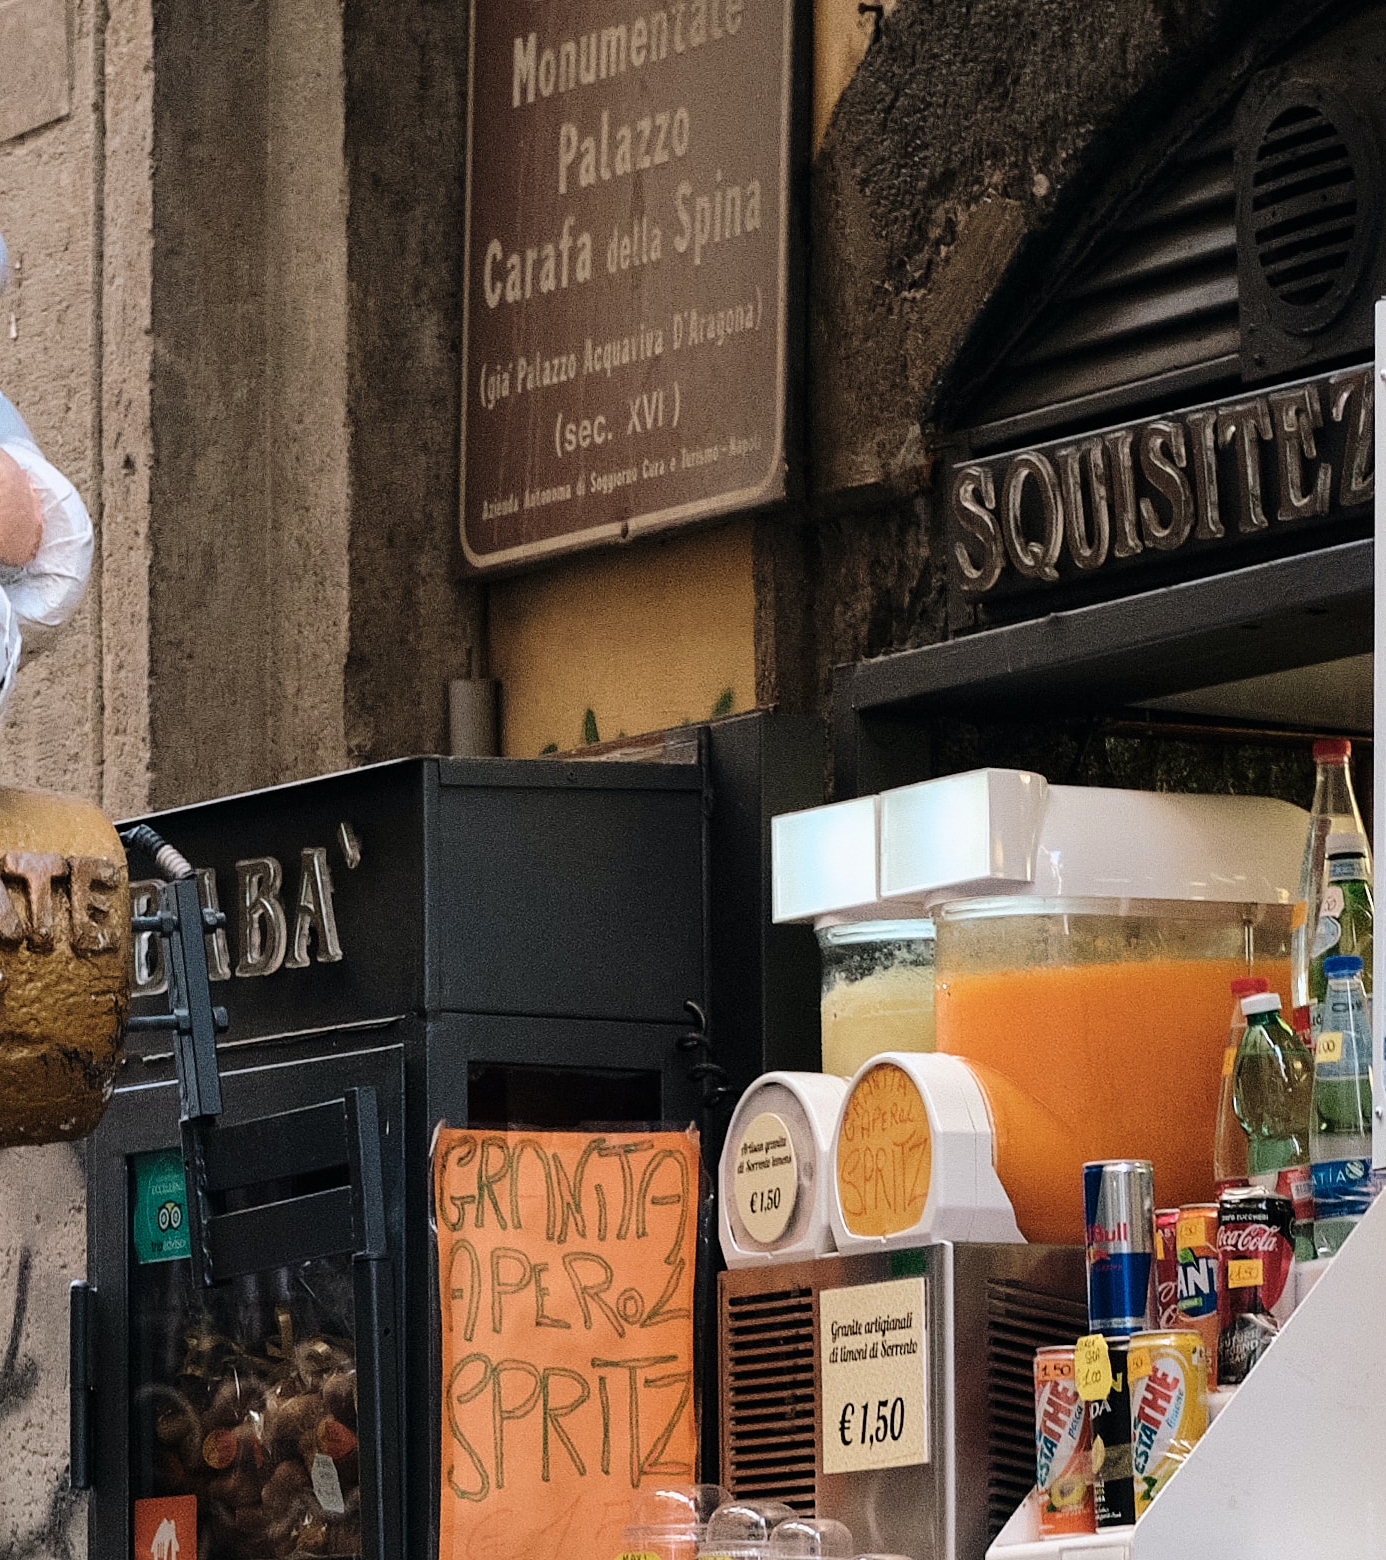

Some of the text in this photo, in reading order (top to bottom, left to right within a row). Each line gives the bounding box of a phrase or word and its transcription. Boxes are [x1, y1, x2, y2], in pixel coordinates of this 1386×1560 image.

[558, 106, 690, 195] Palazzo
[483, 168, 762, 308] Carafa della Spina
[516, 351, 577, 393] Palazzo
[583, 323, 664, 378] Acquaviva
[555, 412, 613, 459] (sec.
[482, 493, 519, 521] Azienda
[524, 482, 572, 509] Autonoma
[577, 471, 586, 496] di
[642, 458, 665, 480] Cura
[681, 442, 720, 470] Turismo
[437, 1134, 692, 1266] GRANITA
[841, 1129, 928, 1216] SPRITZ
[828, 1337, 919, 1364] di limoni di Sorrento
[830, 1309, 914, 1343] Granite artigianali
[448, 1352, 692, 1503] SPRITZ
